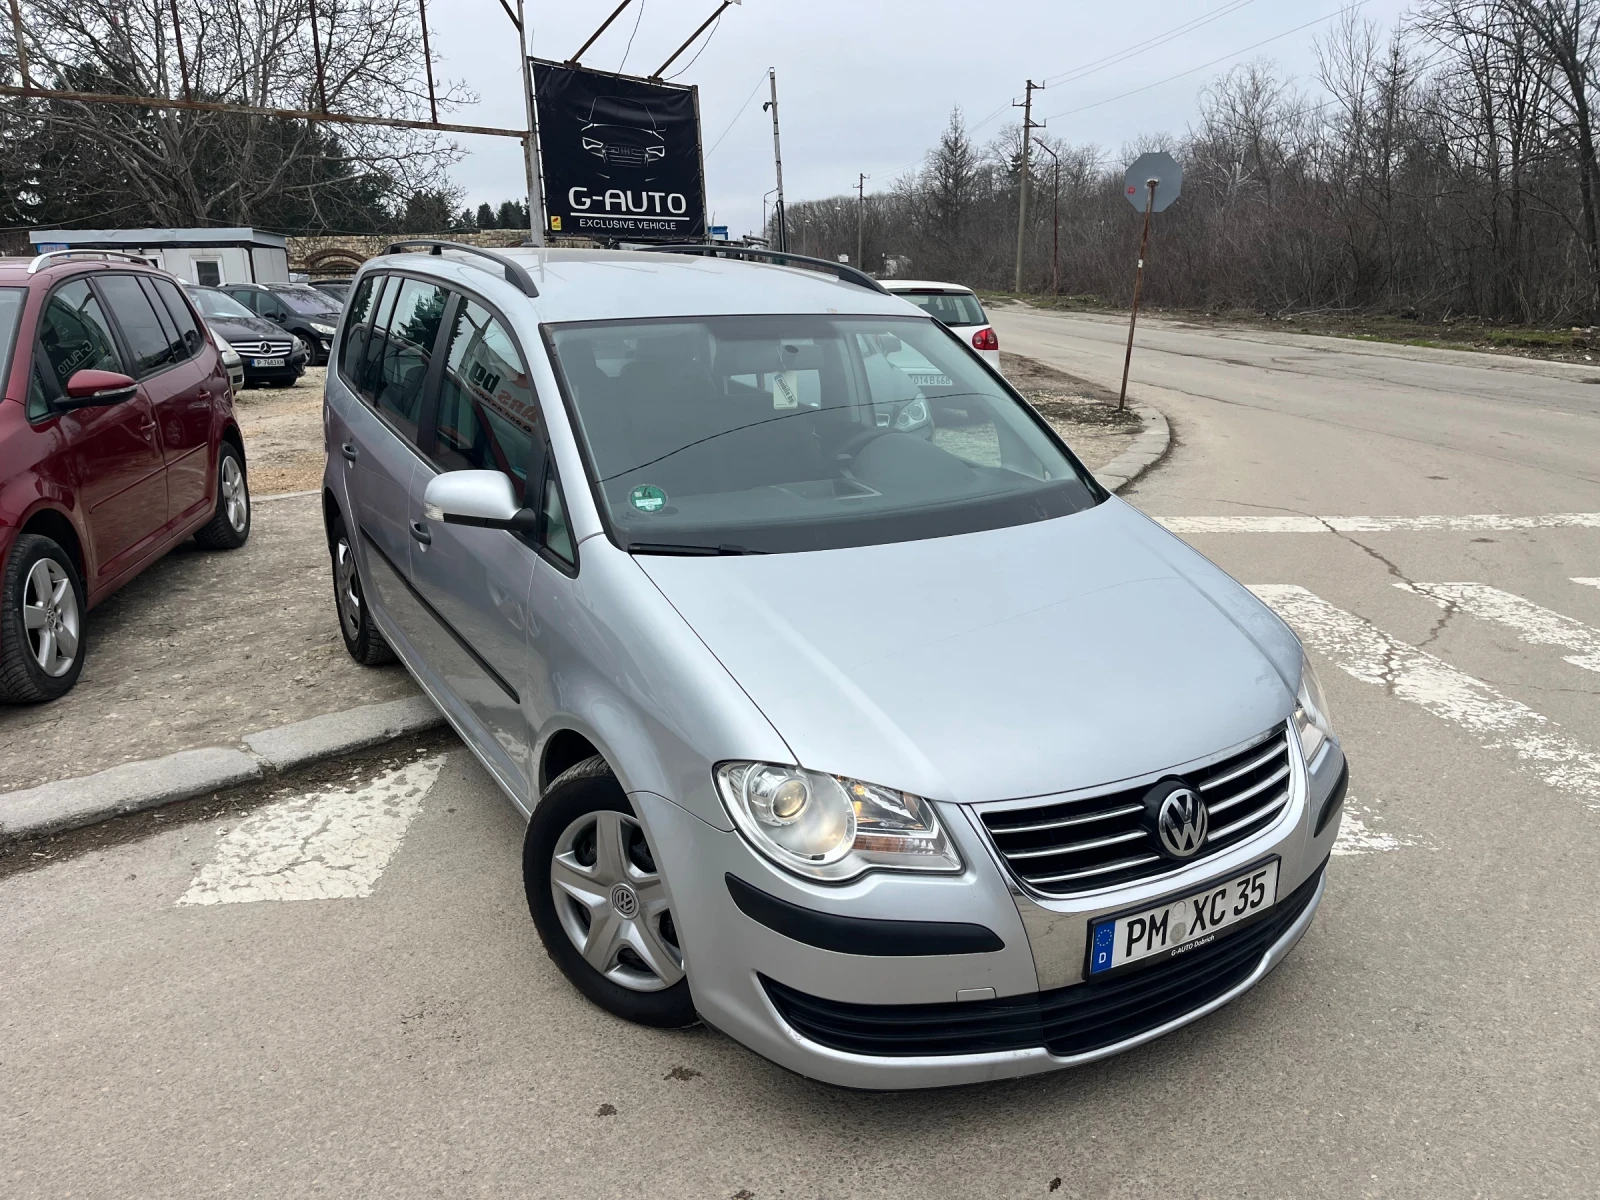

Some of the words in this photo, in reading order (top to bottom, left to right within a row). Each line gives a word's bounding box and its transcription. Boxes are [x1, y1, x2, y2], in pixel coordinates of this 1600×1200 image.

[568, 186, 687, 214] G-AUTO
[579, 218, 636, 229] EXCLUSIVE
[637, 221, 677, 230] VEHICLE
[642, 487, 653, 498] 4
[1125, 909, 1170, 957] PM
[1189, 888, 1227, 936] XC
[1233, 870, 1267, 916] 35
[1171, 943, 1193, 957] G-AUTO
[1194, 934, 1215, 948] Dobrich
[1098, 952, 1108, 964] D
